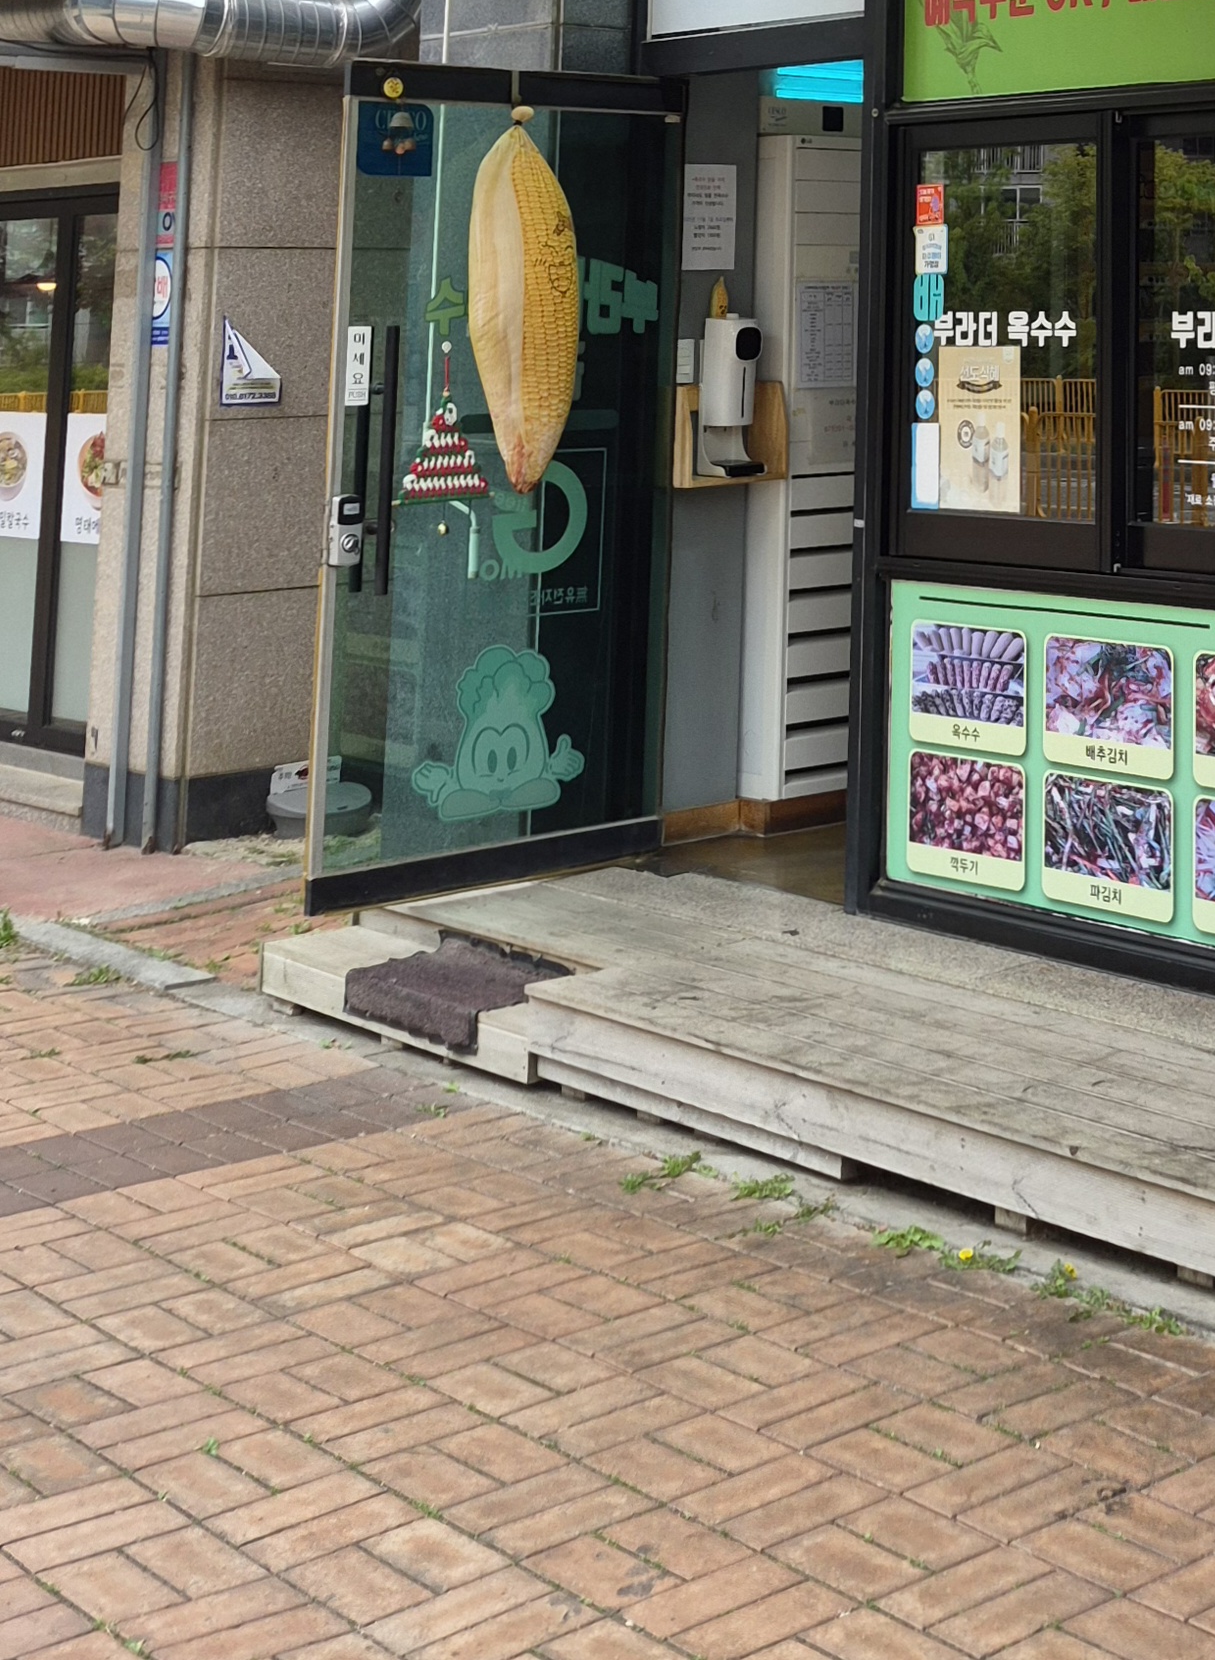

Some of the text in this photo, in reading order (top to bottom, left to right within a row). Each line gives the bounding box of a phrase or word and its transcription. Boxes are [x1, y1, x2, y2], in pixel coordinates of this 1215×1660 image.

[934, 311, 1077, 347] 부라더 옥수수
[1178, 365, 1194, 376] am
[1178, 420, 1194, 431] am
[951, 723, 981, 742] 옥수수
[1085, 744, 1129, 766] 배추김치
[949, 856, 979, 876] 깍두기
[1089, 885, 1122, 905] 파김치
